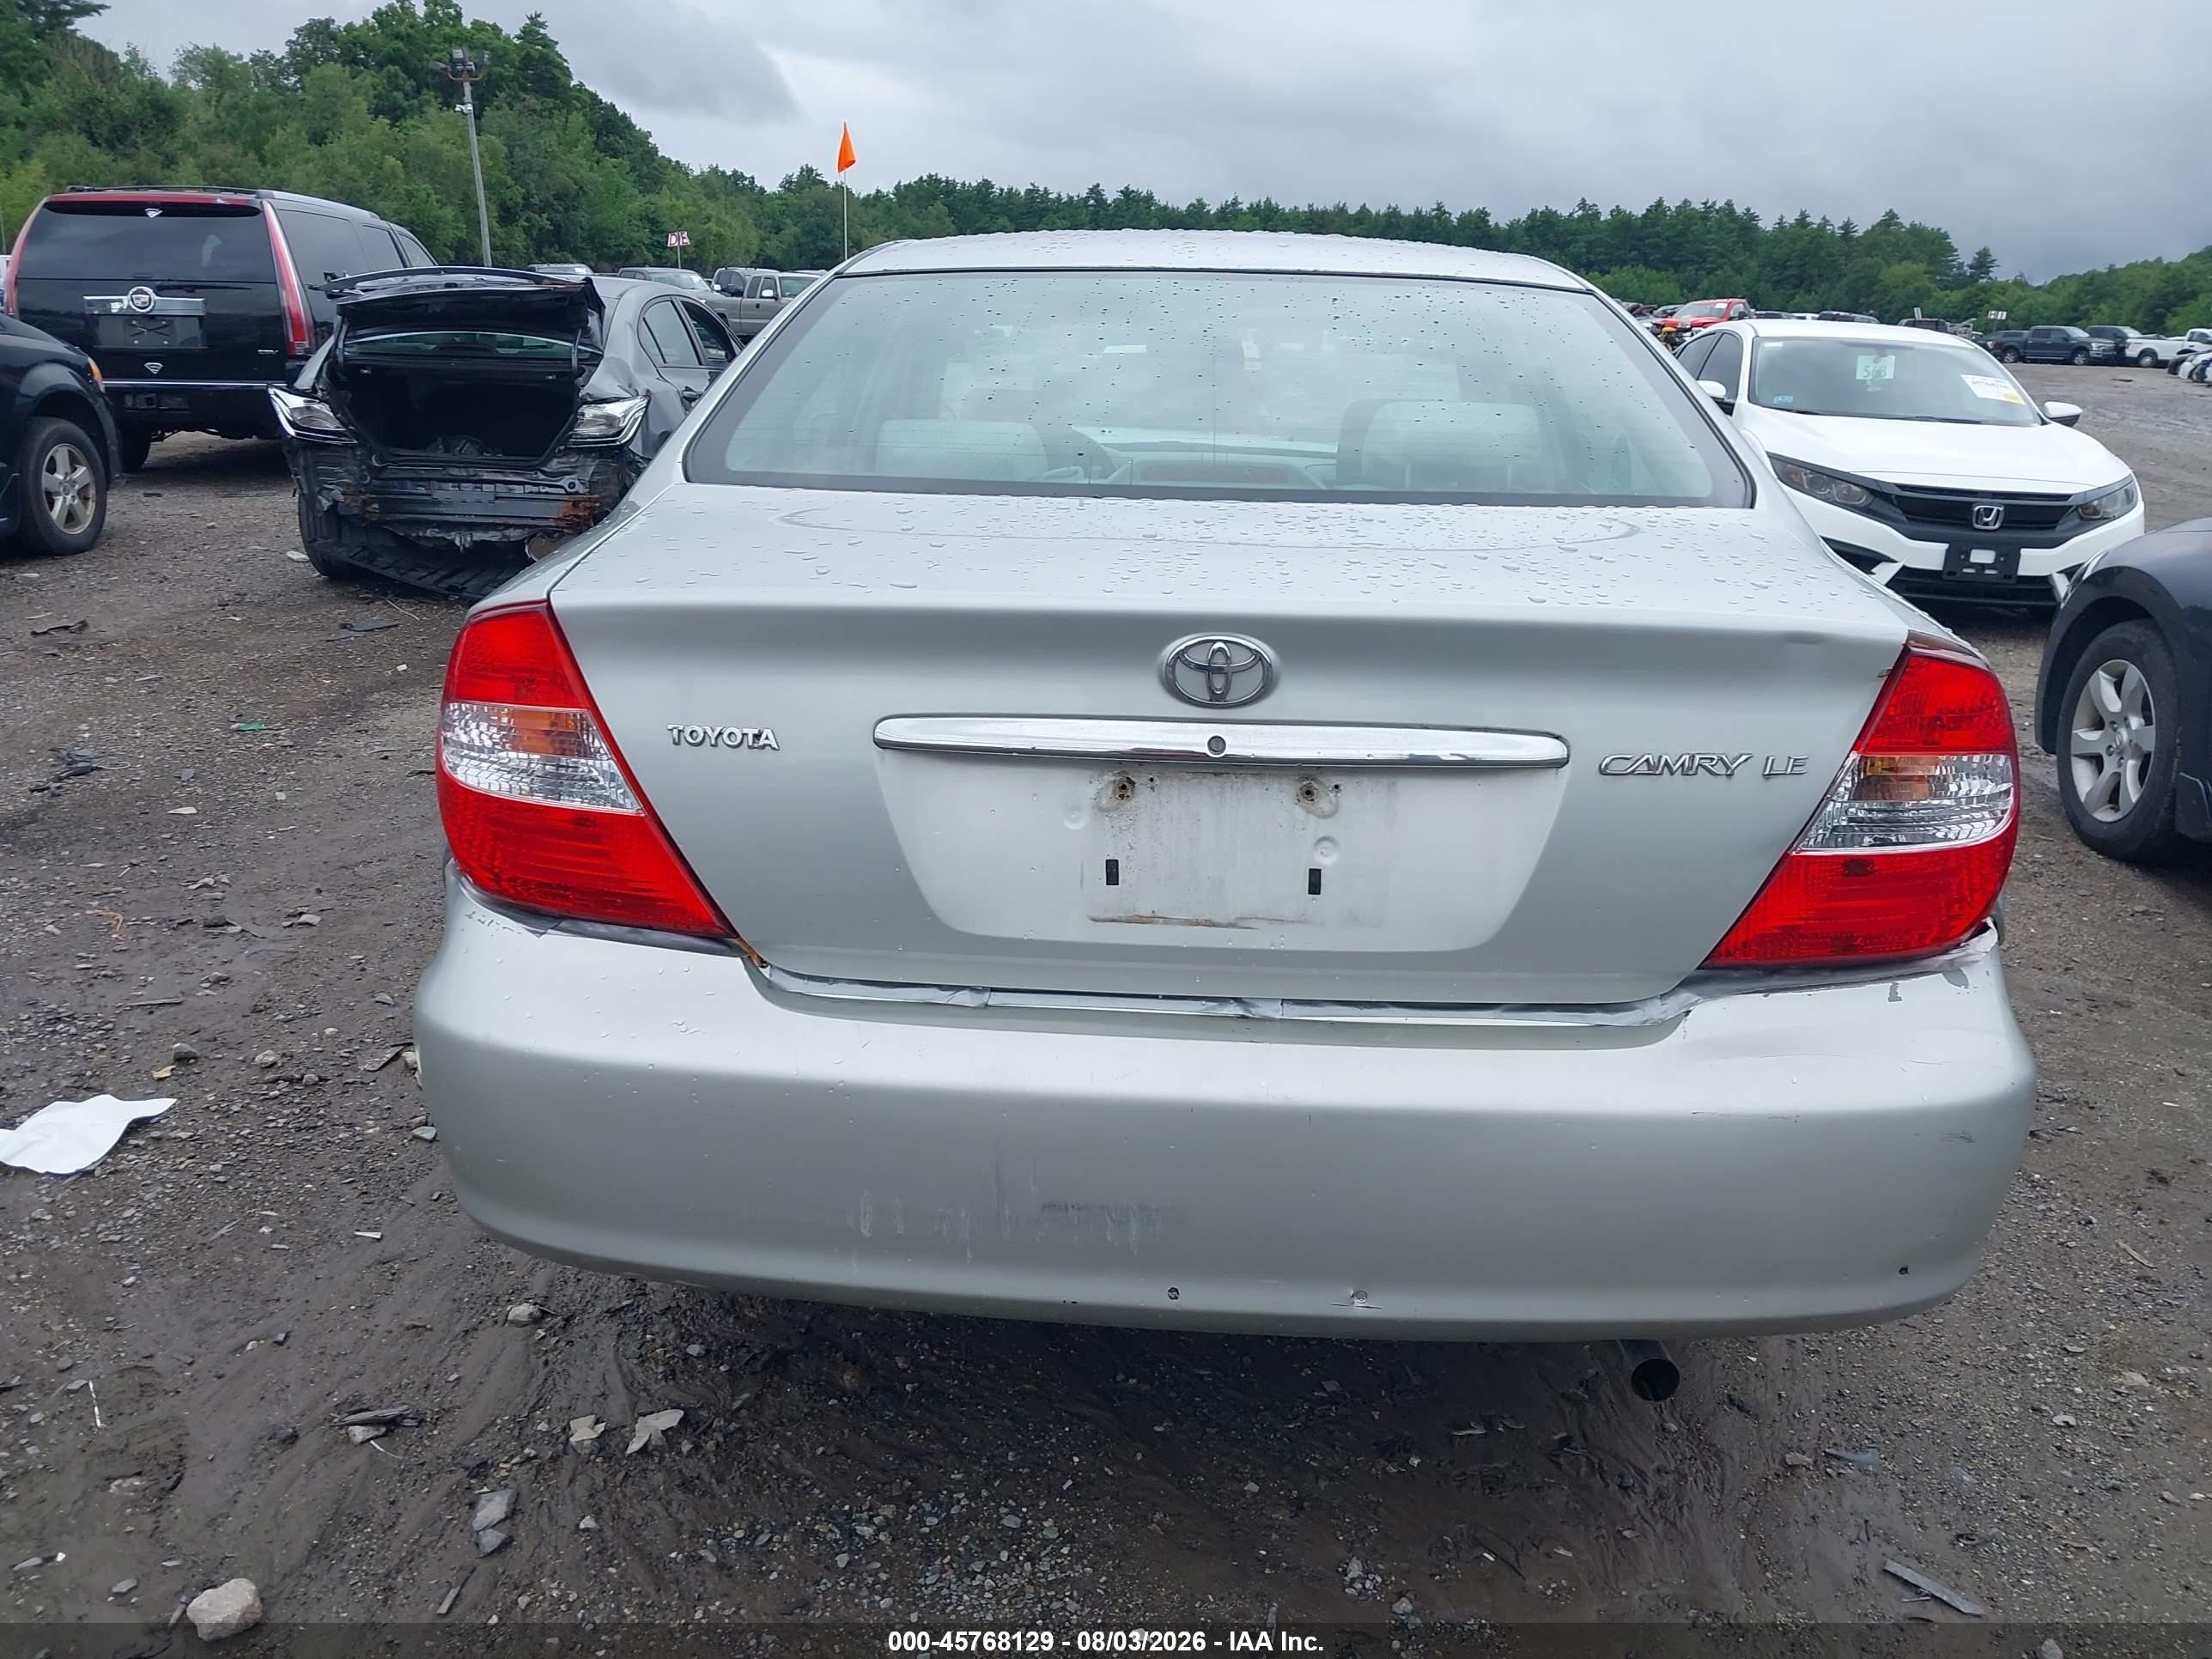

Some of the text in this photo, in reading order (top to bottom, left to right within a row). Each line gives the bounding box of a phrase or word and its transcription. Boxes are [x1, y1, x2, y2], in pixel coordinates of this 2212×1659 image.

[667, 724, 780, 750] TOYOTA
[1599, 753, 1808, 777] CAMRY LE
